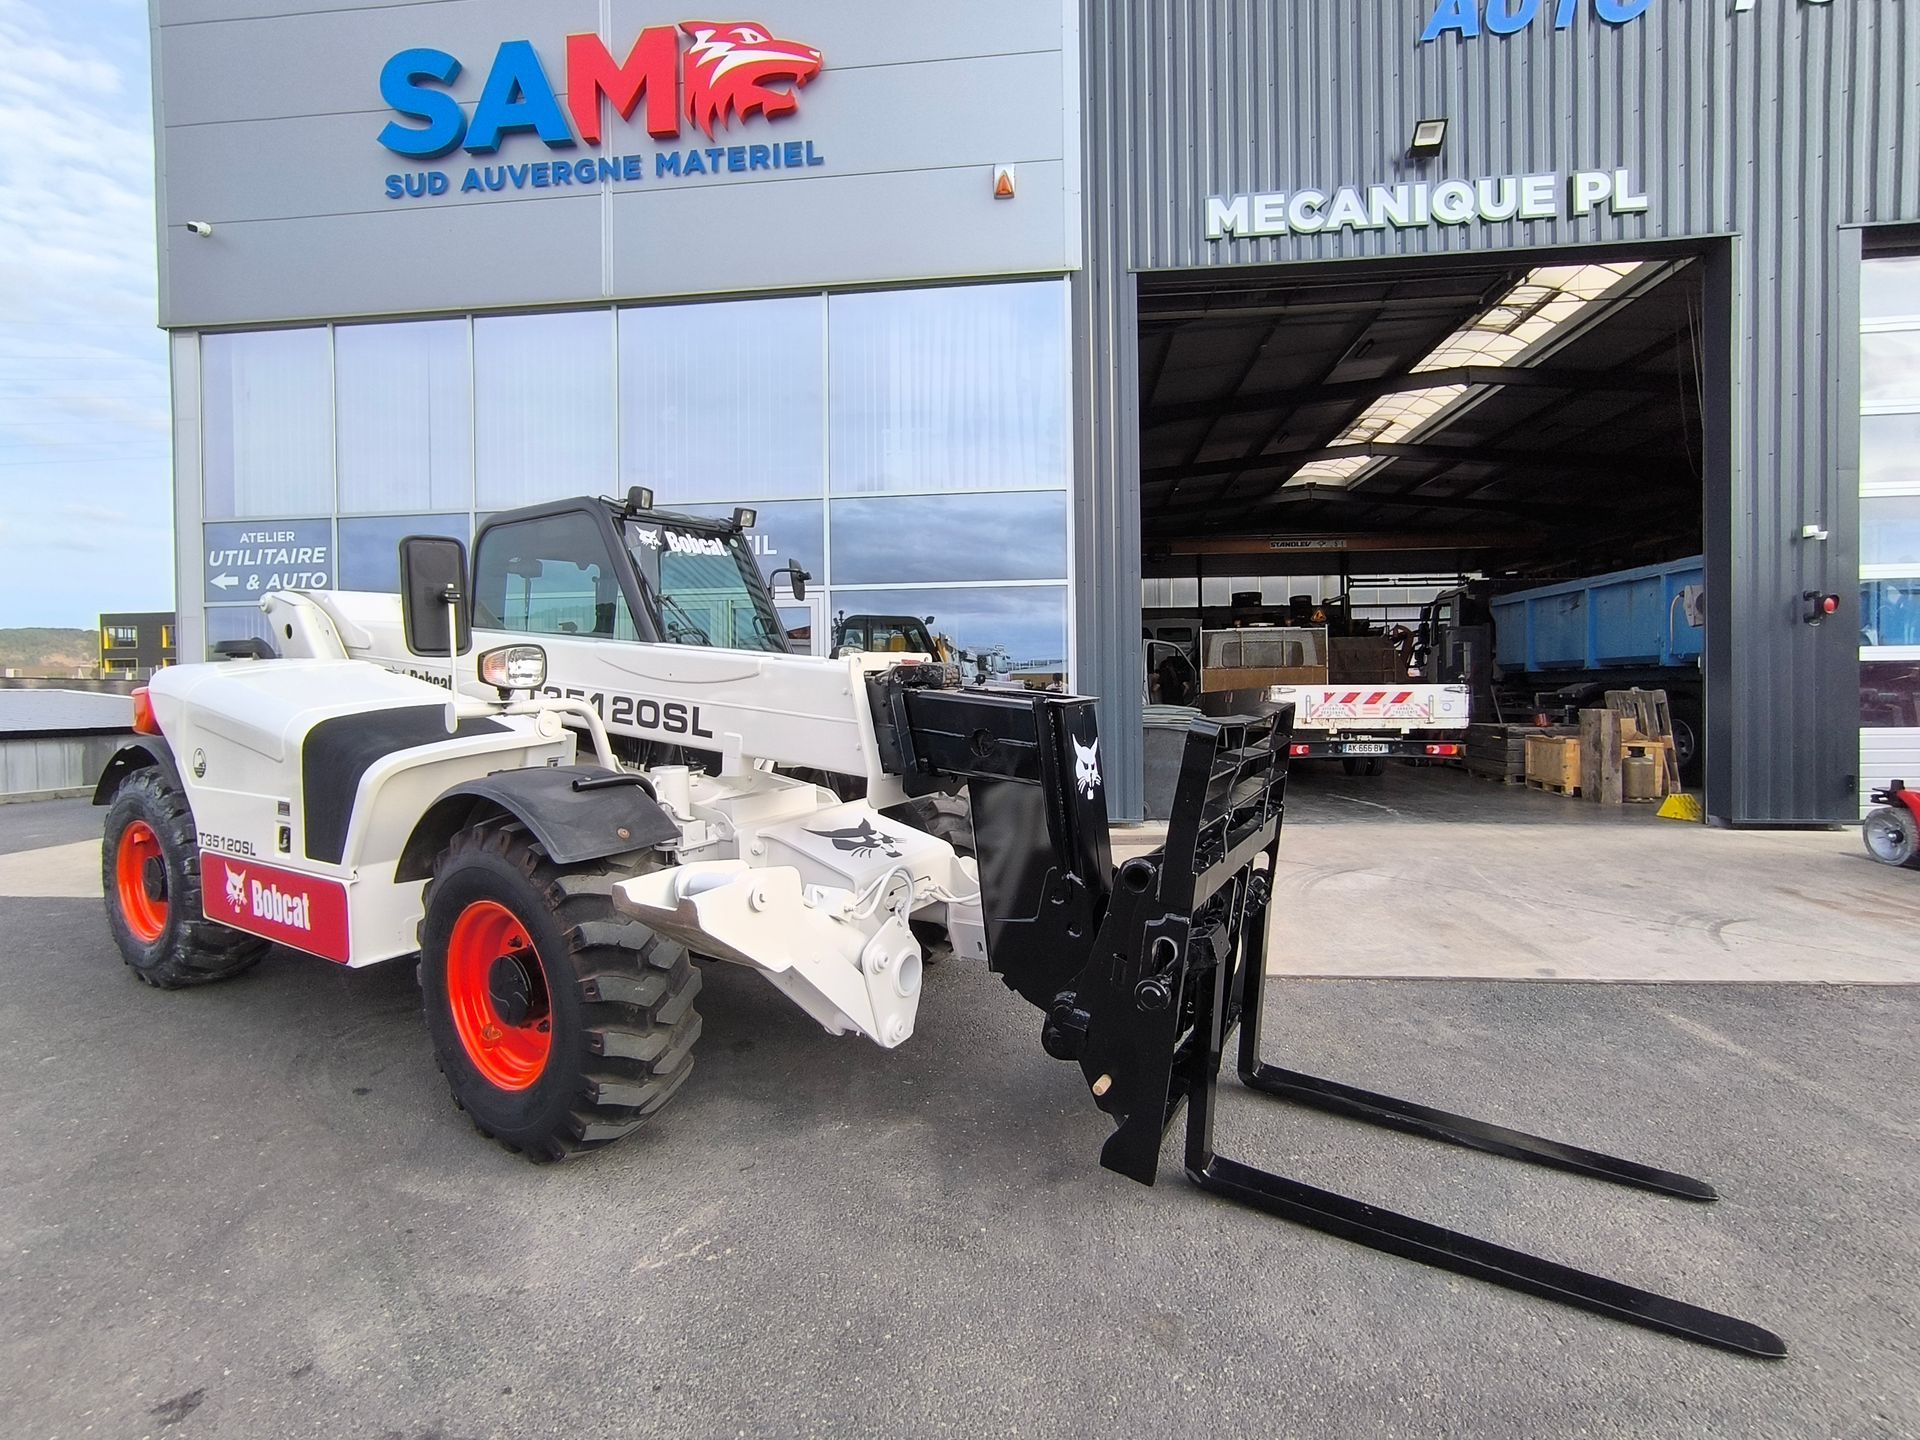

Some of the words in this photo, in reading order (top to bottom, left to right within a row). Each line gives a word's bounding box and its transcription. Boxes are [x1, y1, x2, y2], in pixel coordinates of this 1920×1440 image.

[377, 25, 680, 160] SAM
[385, 170, 449, 199] SUD
[461, 155, 642, 192] AUVERGNE
[656, 140, 825, 177] MATERIEL
[1205, 173, 1557, 239] MECANIQUE
[1575, 168, 1648, 216] PL
[240, 531, 295, 544] ATELIER
[664, 530, 728, 557] Bobcat
[209, 547, 327, 567] UTILITAIRE
[246, 574, 260, 590] &
[266, 572, 328, 589] AUTO
[198, 832, 256, 857] T35120SL
[251, 879, 311, 931] Bobcat
